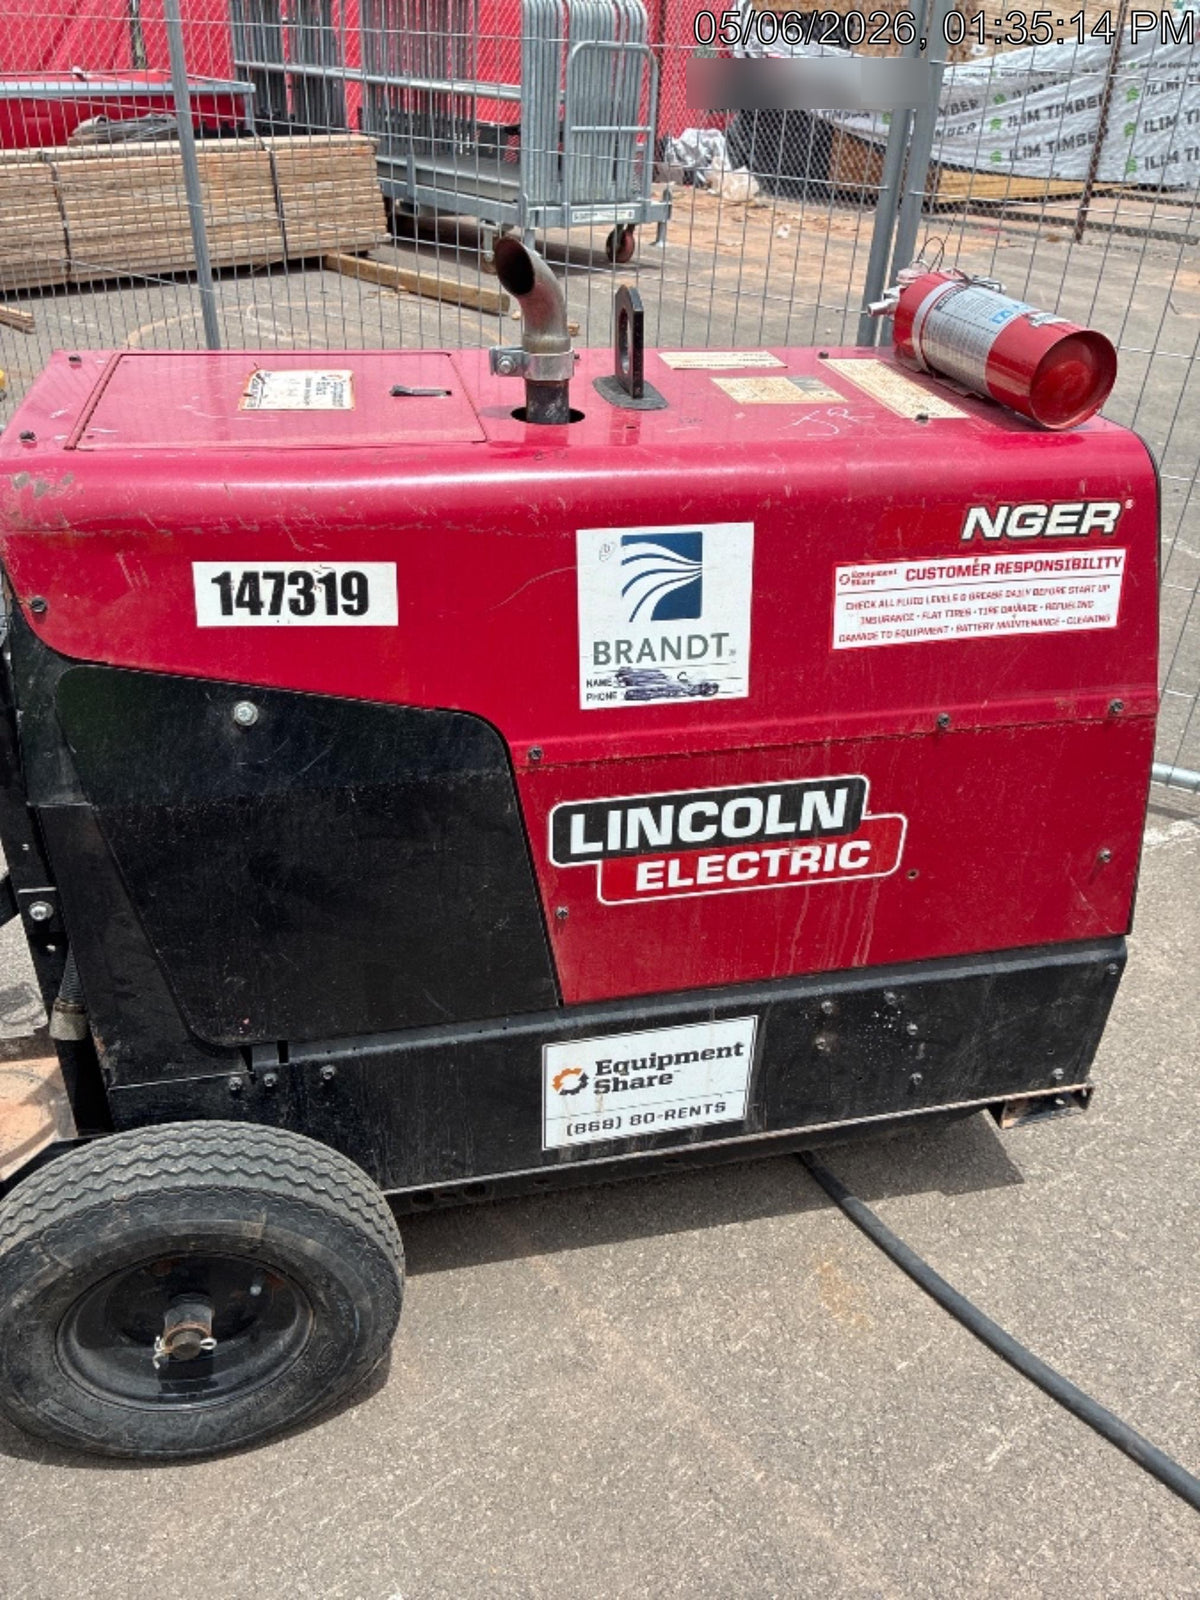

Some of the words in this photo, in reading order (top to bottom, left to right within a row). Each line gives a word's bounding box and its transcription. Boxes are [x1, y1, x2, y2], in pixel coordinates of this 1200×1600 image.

[1144, 114, 1178, 133] ILIM
[1145, 150, 1179, 170] ILIM
[905, 563, 991, 582] CUSTOMER
[994, 556, 1123, 574] RESPONSIBILITY
[211, 570, 369, 616] 147319
[845, 600, 876, 611] CHECK
[878, 599, 896, 608] ALL
[897, 596, 924, 607] FLUID
[926, 594, 957, 604] LEVELS
[1032, 586, 1067, 597] BEFORE
[1068, 584, 1096, 594] START
[1097, 584, 1111, 593] UP
[860, 612, 914, 625] INSURANCE
[922, 610, 942, 620] FLAT
[881, 630, 893, 639] TO
[895, 625, 949, 638] EQUIPMENT
[956, 621, 994, 633] BATTERY
[593, 632, 729, 665] BRANDT
[569, 787, 849, 854] LINCOLN
[635, 840, 871, 891] ELECTRIC
[594, 1041, 745, 1076] Equipment
[594, 1072, 674, 1095] Share
[629, 1101, 727, 1126] 80-RENTS
